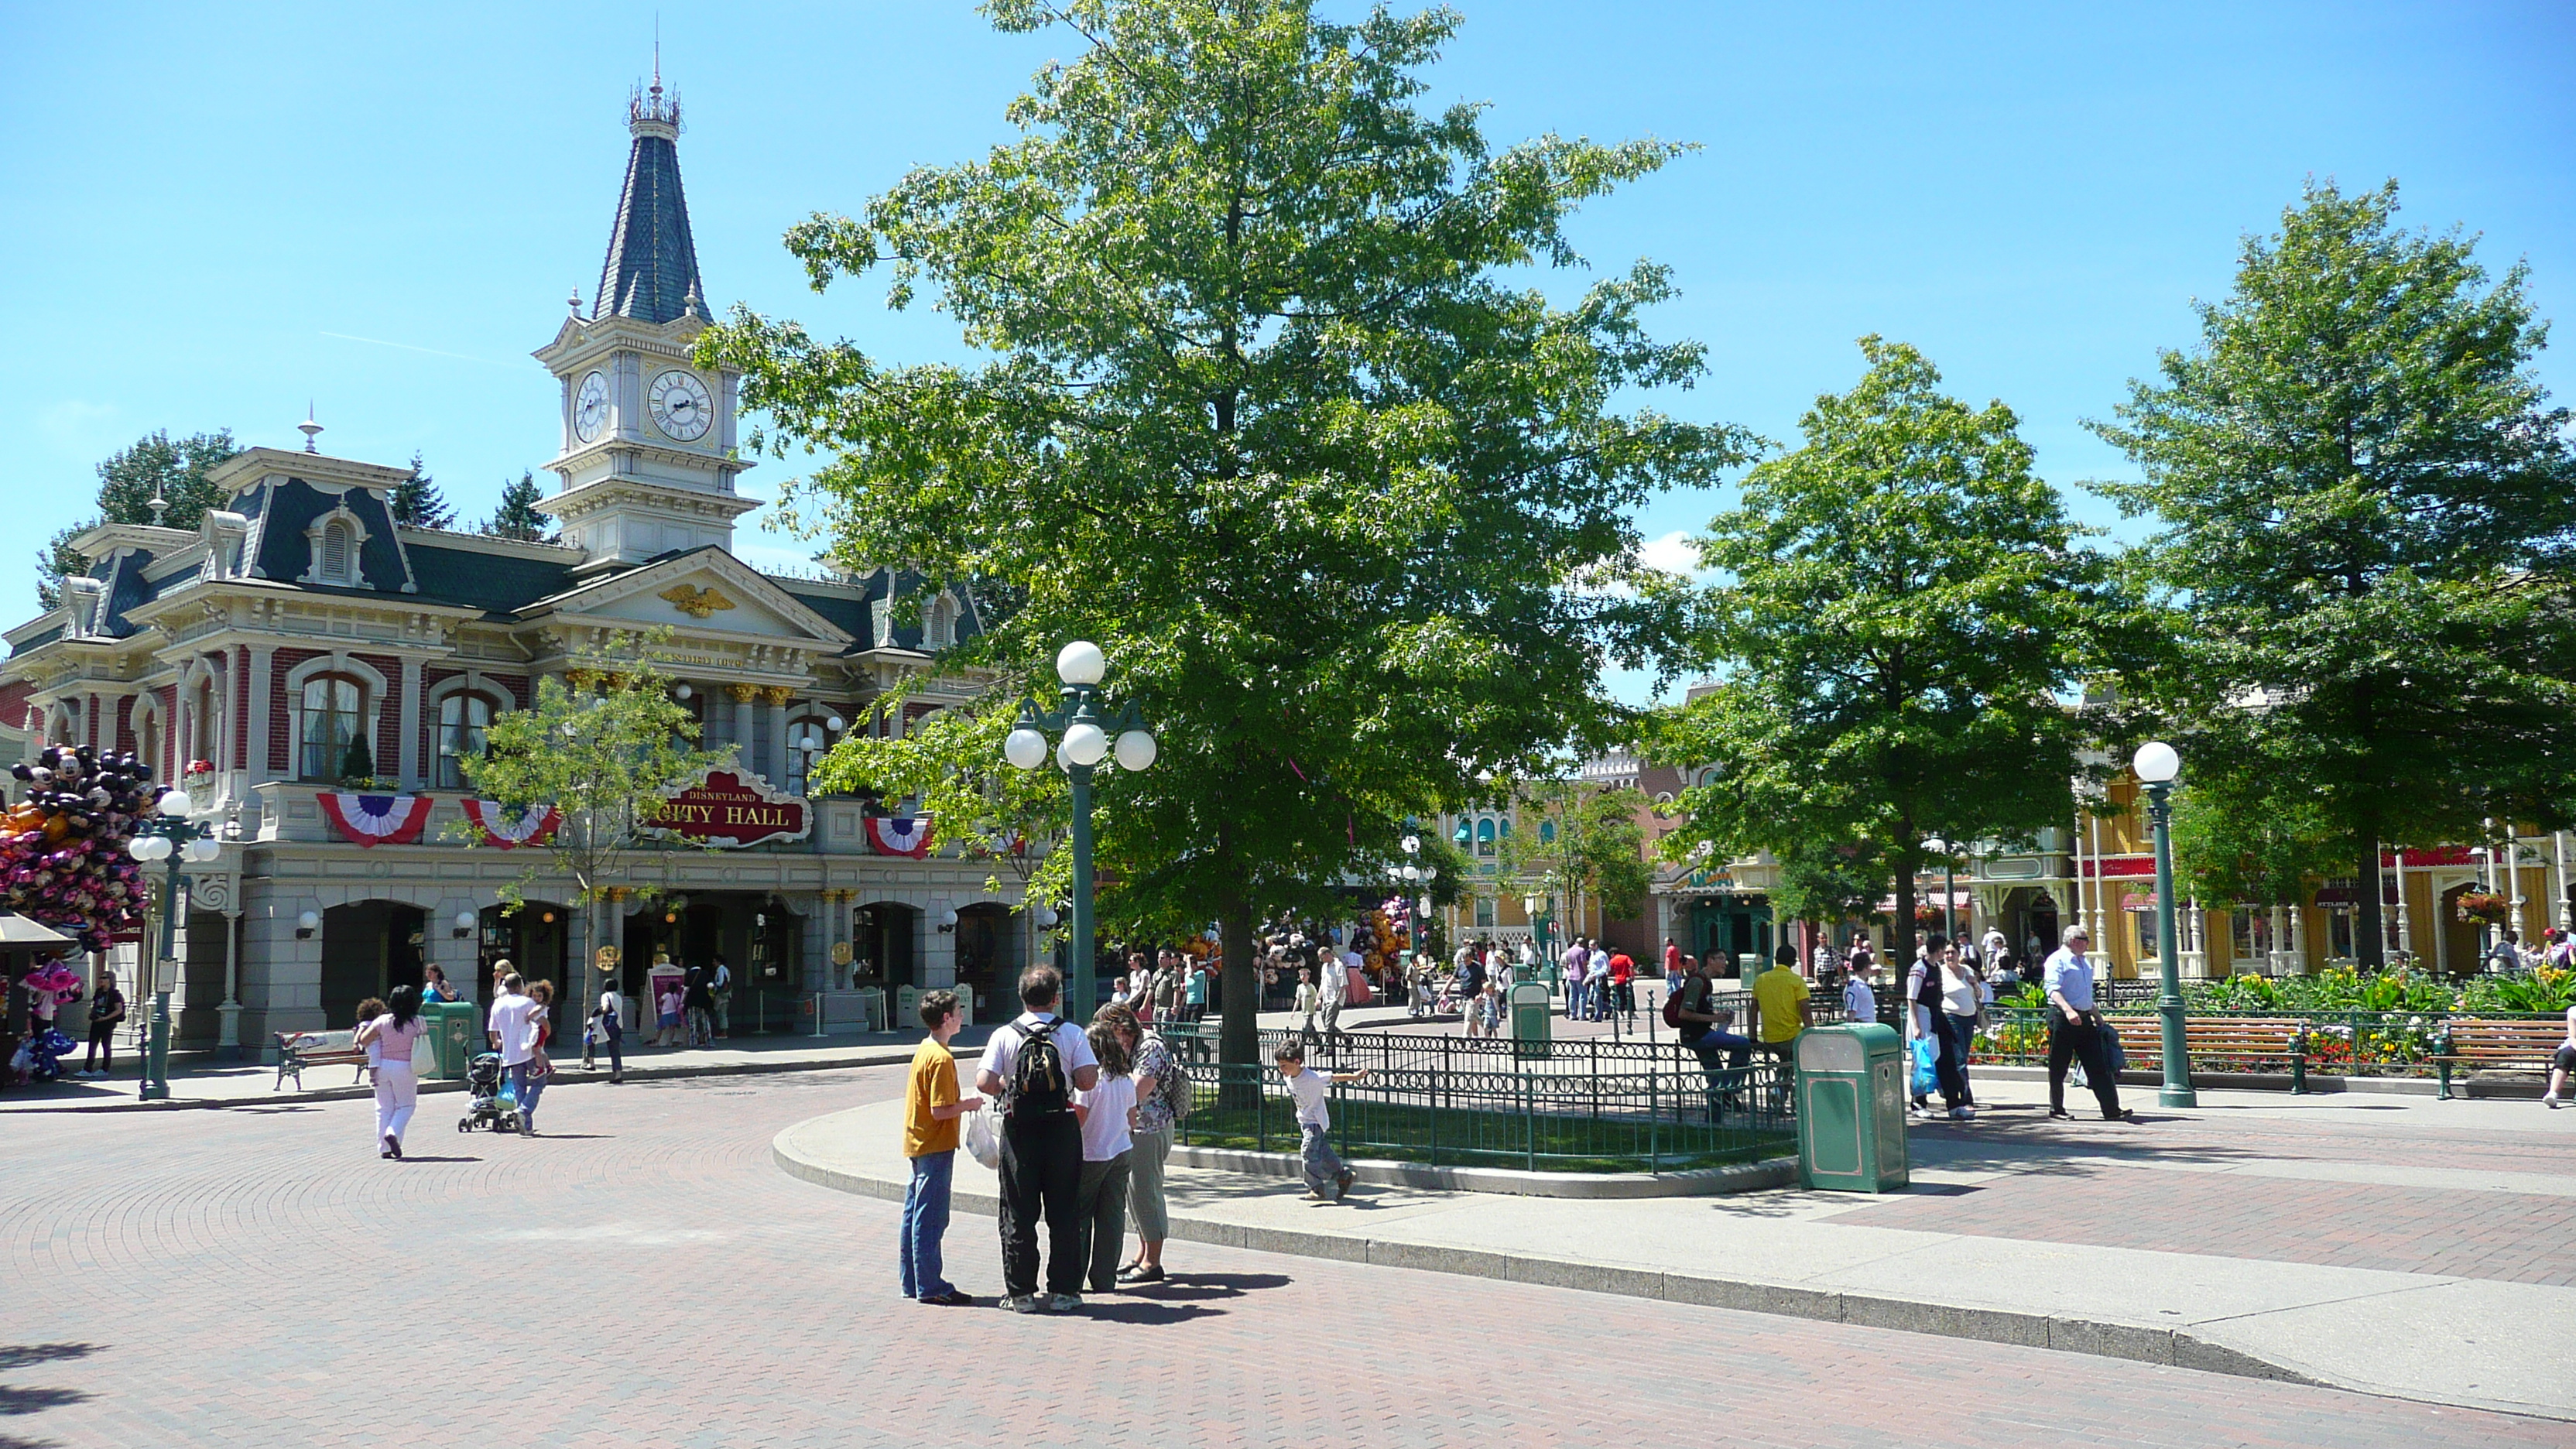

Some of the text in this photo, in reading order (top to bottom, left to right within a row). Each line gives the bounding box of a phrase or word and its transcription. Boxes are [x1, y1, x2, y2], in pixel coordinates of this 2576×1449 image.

[690, 791, 756, 802] DISNEYLAND
[656, 803, 789, 826] CITY HALL
